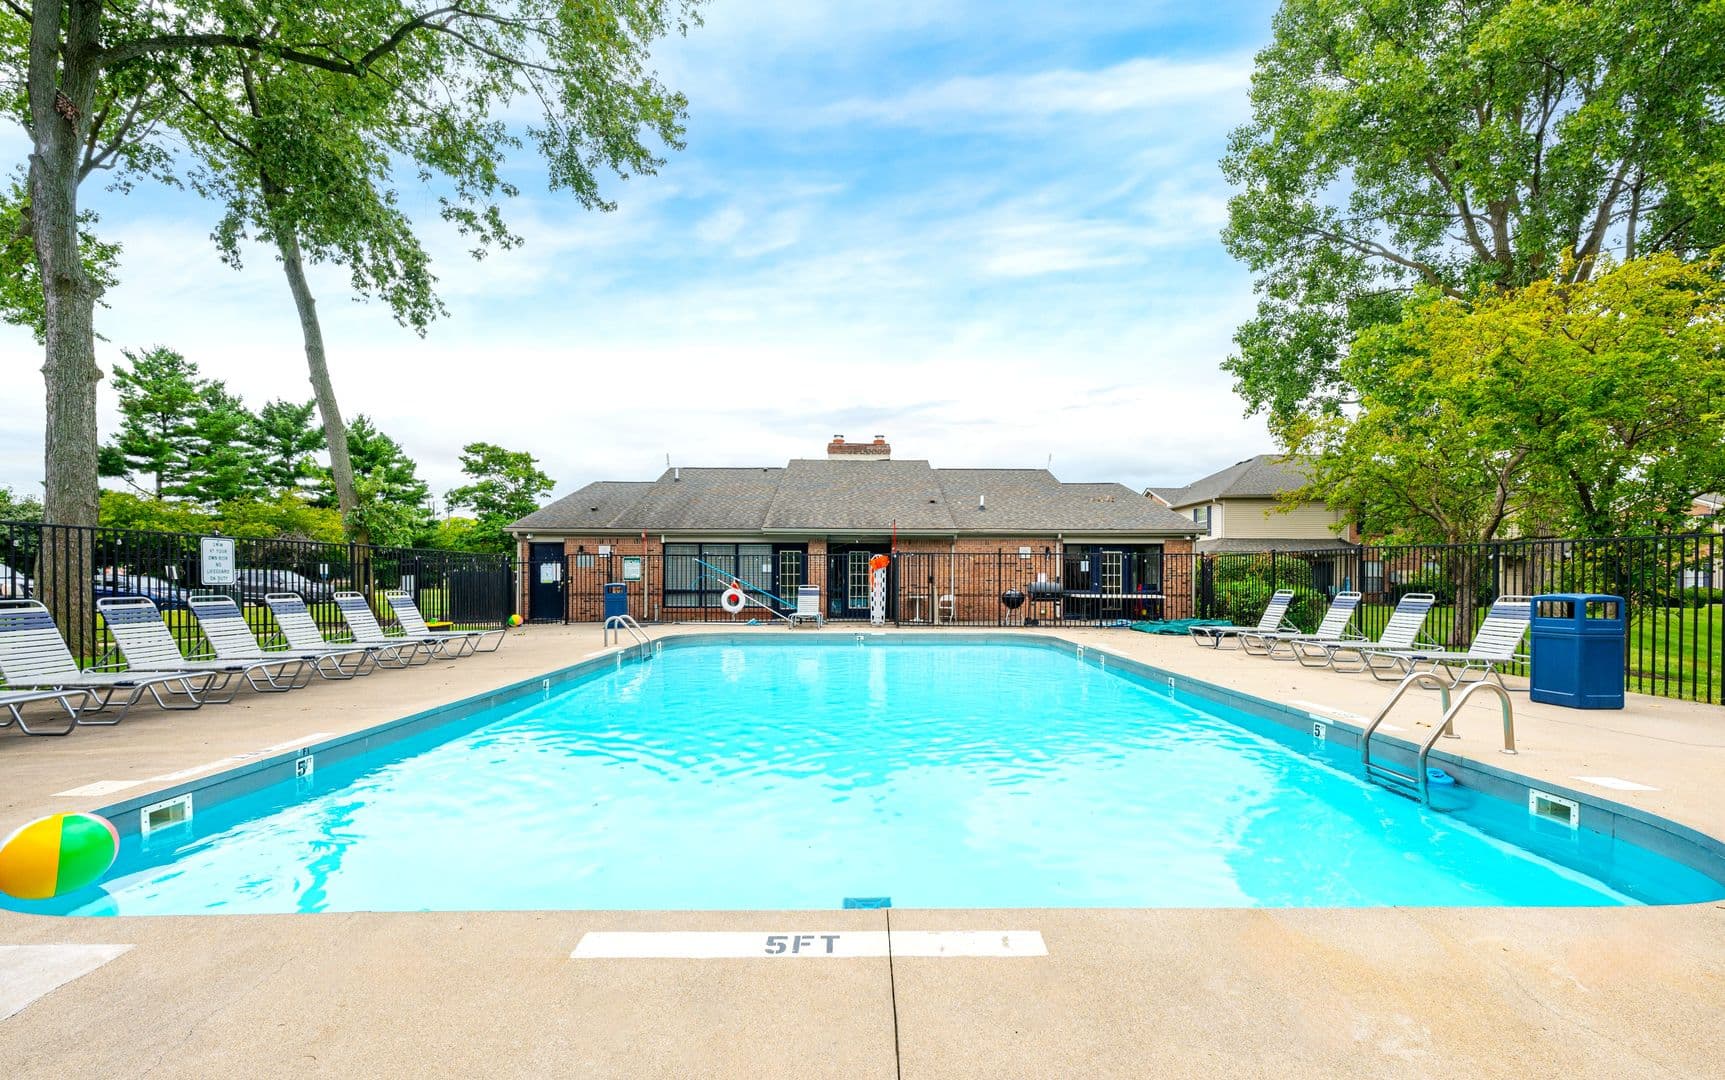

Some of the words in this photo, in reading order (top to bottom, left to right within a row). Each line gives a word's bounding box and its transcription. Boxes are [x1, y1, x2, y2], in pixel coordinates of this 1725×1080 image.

[1314, 724, 1321, 737] 5
[298, 759, 306, 777] 5
[764, 935, 841, 954] 5FT
